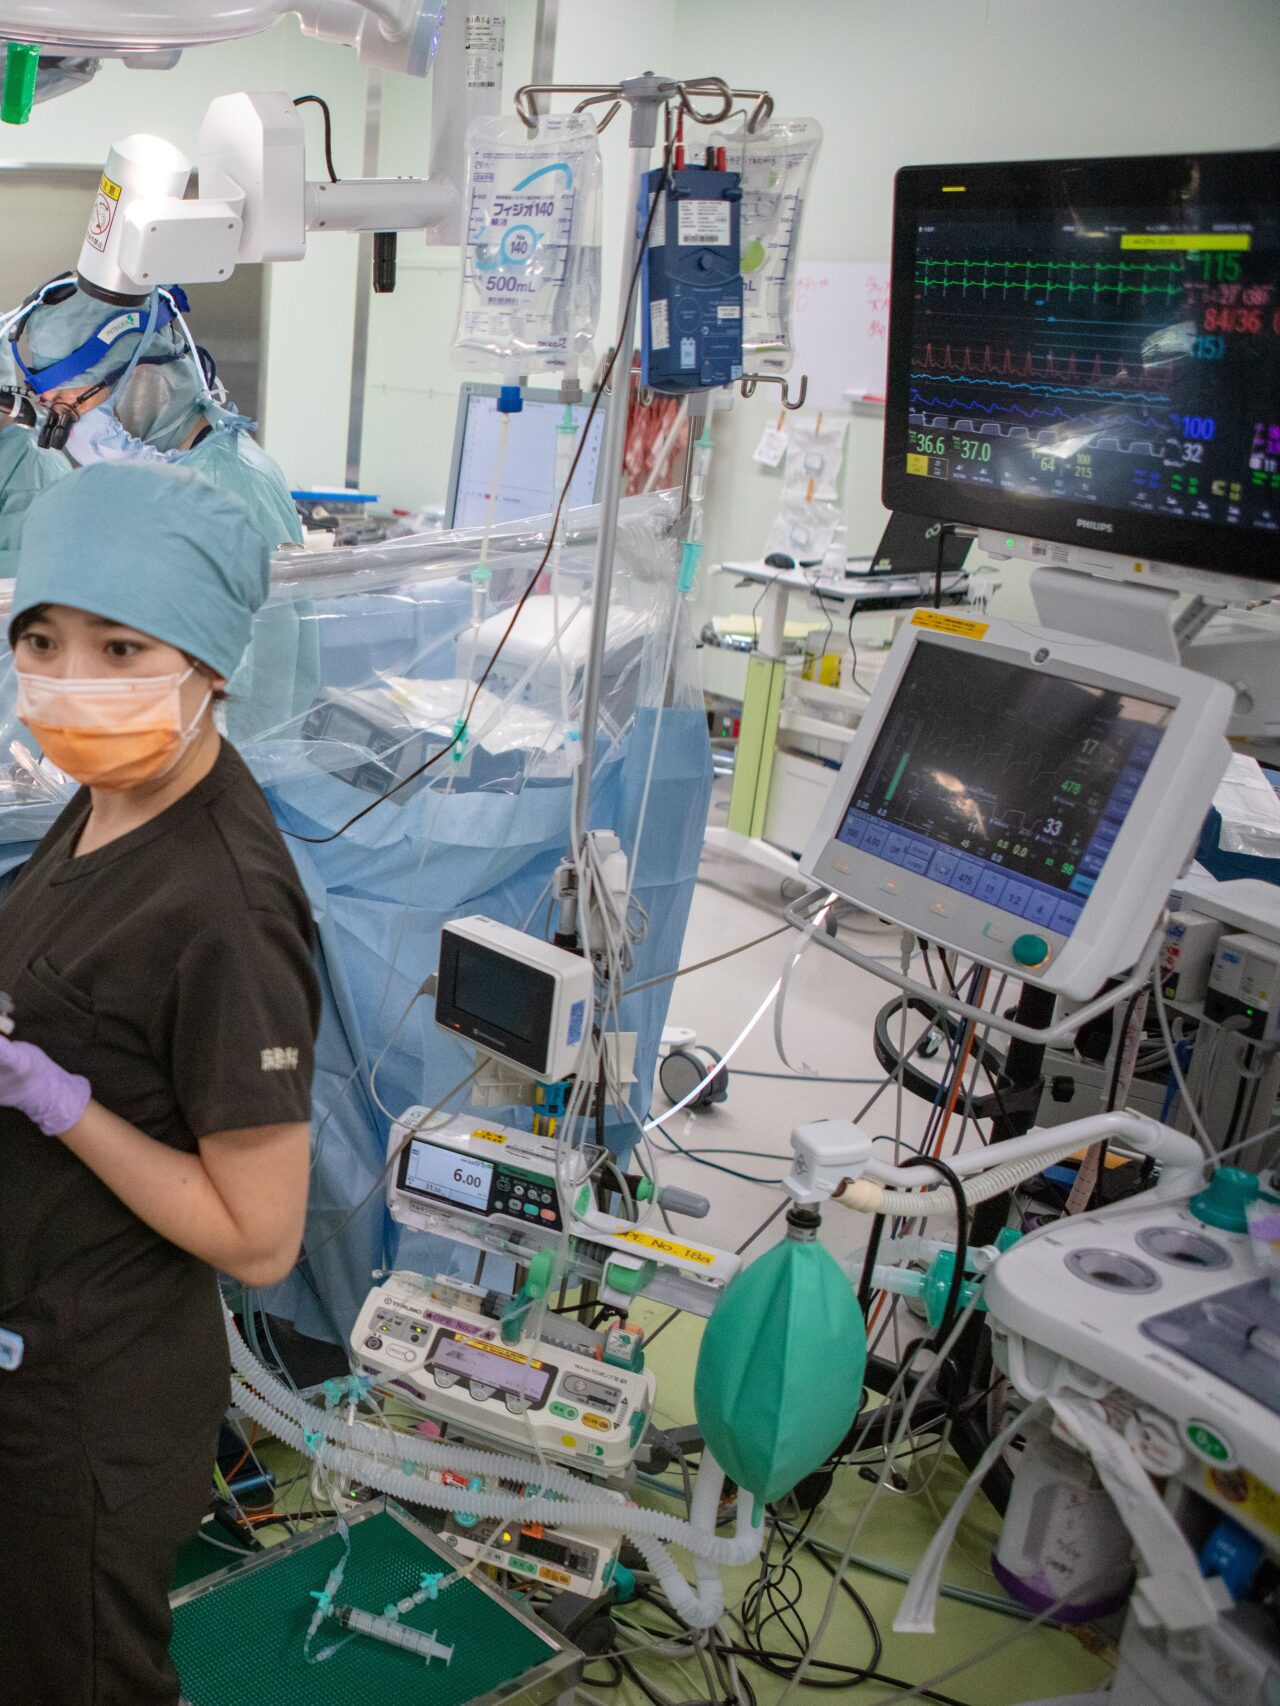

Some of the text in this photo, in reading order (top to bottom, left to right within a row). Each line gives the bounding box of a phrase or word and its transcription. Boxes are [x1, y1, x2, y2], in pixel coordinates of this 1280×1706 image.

[493, 201, 554, 217] フィジオ140
[510, 241, 528, 254] 140
[486, 276, 536, 293] 500mL
[1183, 416, 1215, 440] 100
[916, 433, 945, 455] 36.6
[961, 440, 991, 461] 37.0
[1182, 444, 1203, 463] 32
[1040, 457, 1056, 472] 64
[1076, 518, 1114, 533] PHILIPS
[1043, 818, 1063, 836] 33
[453, 1168, 481, 1188] 6.00
[651, 1240, 677, 1254] No.
[684, 1250, 711, 1264] 18a
[392, 1301, 422, 1315] TERUMO
